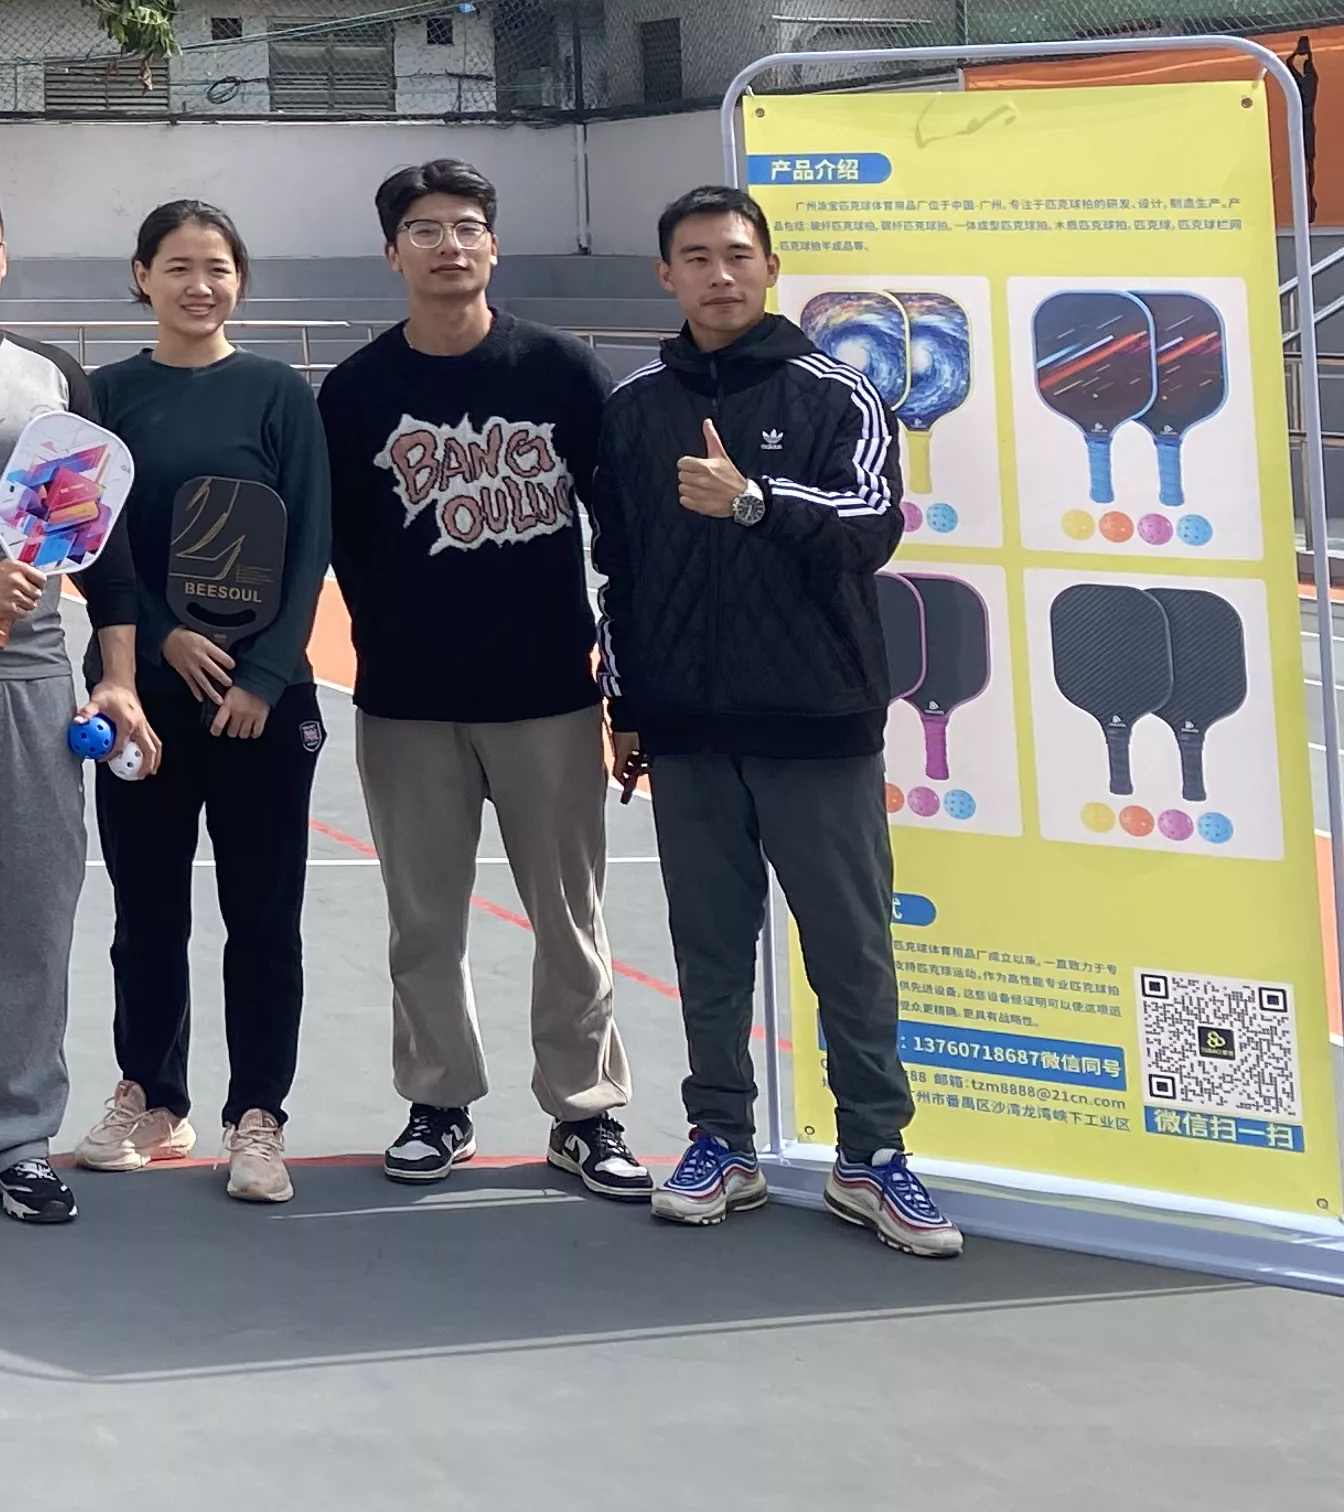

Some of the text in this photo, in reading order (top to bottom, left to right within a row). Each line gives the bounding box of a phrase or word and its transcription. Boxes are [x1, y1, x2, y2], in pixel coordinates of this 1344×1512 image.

[771, 159, 859, 181] 产品介绍
[390, 423, 556, 504] BANG
[185, 581, 262, 603] BEESOUL
[1154, 1108, 1294, 1150] 微信扫一扫
